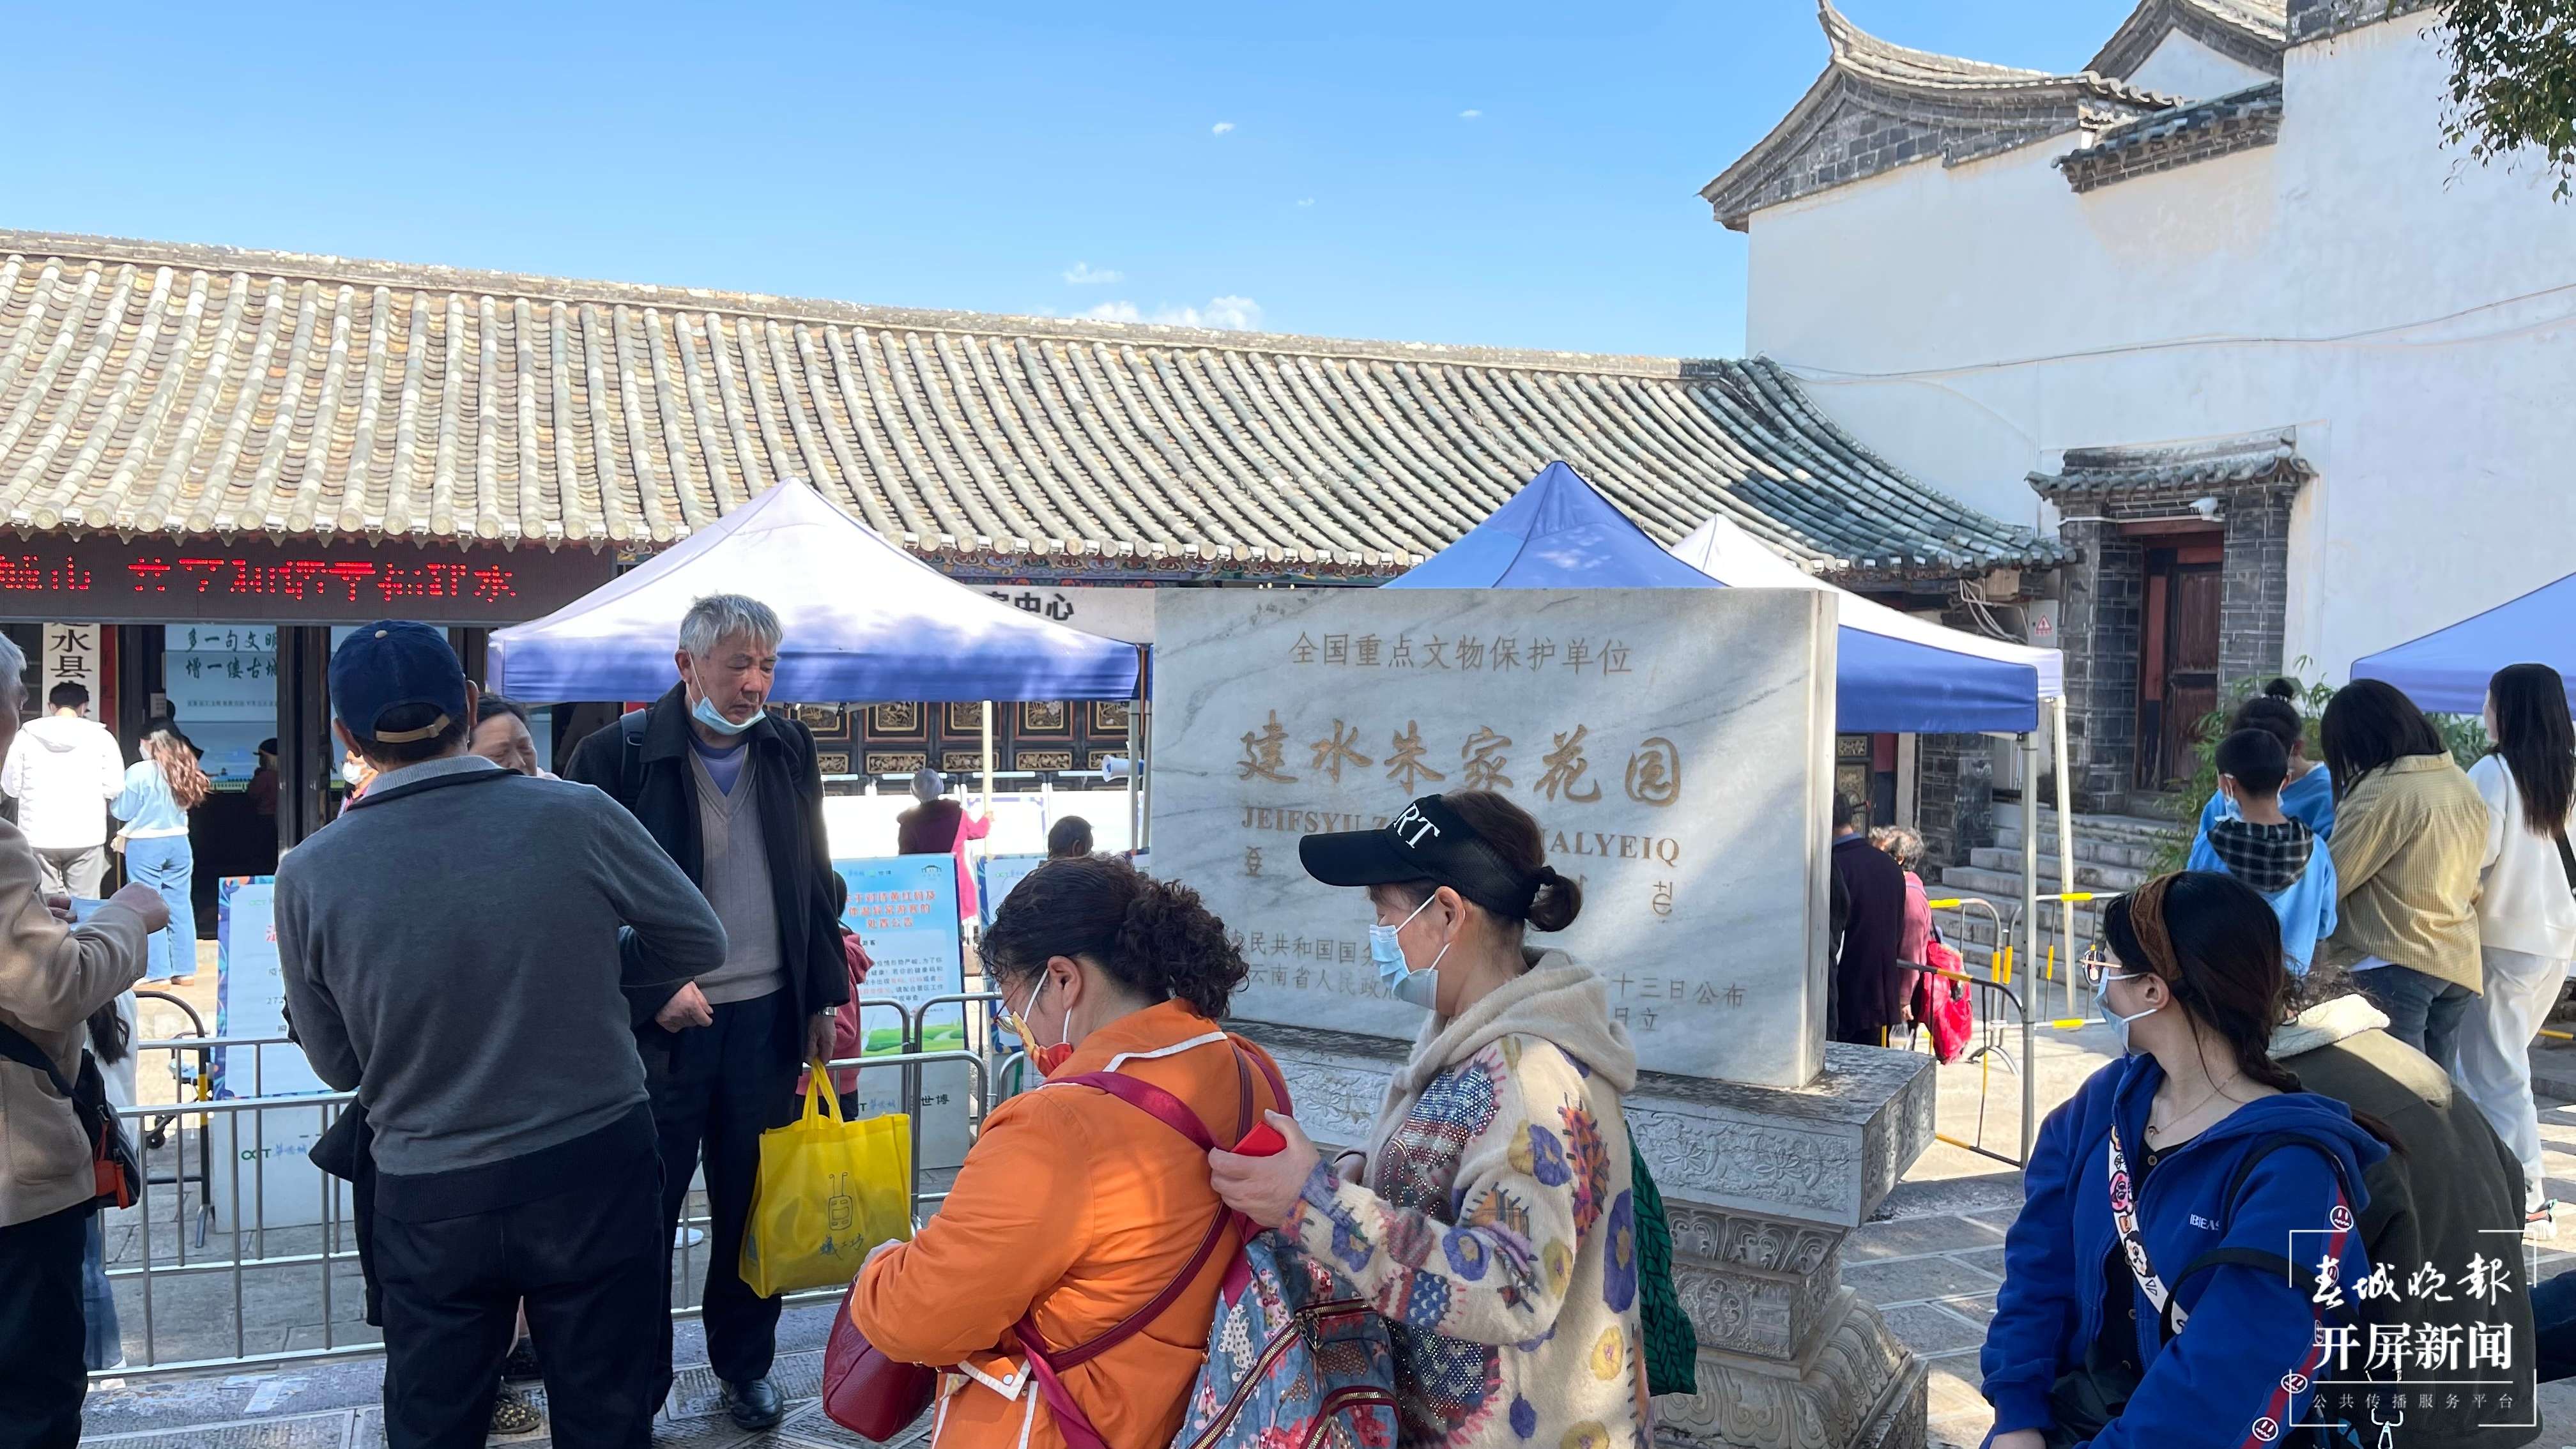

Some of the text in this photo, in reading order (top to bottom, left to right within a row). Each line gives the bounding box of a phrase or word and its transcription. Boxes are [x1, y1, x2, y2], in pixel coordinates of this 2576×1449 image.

[49, 622, 92, 678] 水县
[1289, 630, 1633, 676] 全国重点文物保护单位
[1239, 709, 1682, 808] 建水朱家花园
[1393, 802, 1441, 849] RT
[1542, 828, 1680, 868] ALYEIQ
[1611, 972, 1747, 1010] 十三日公布
